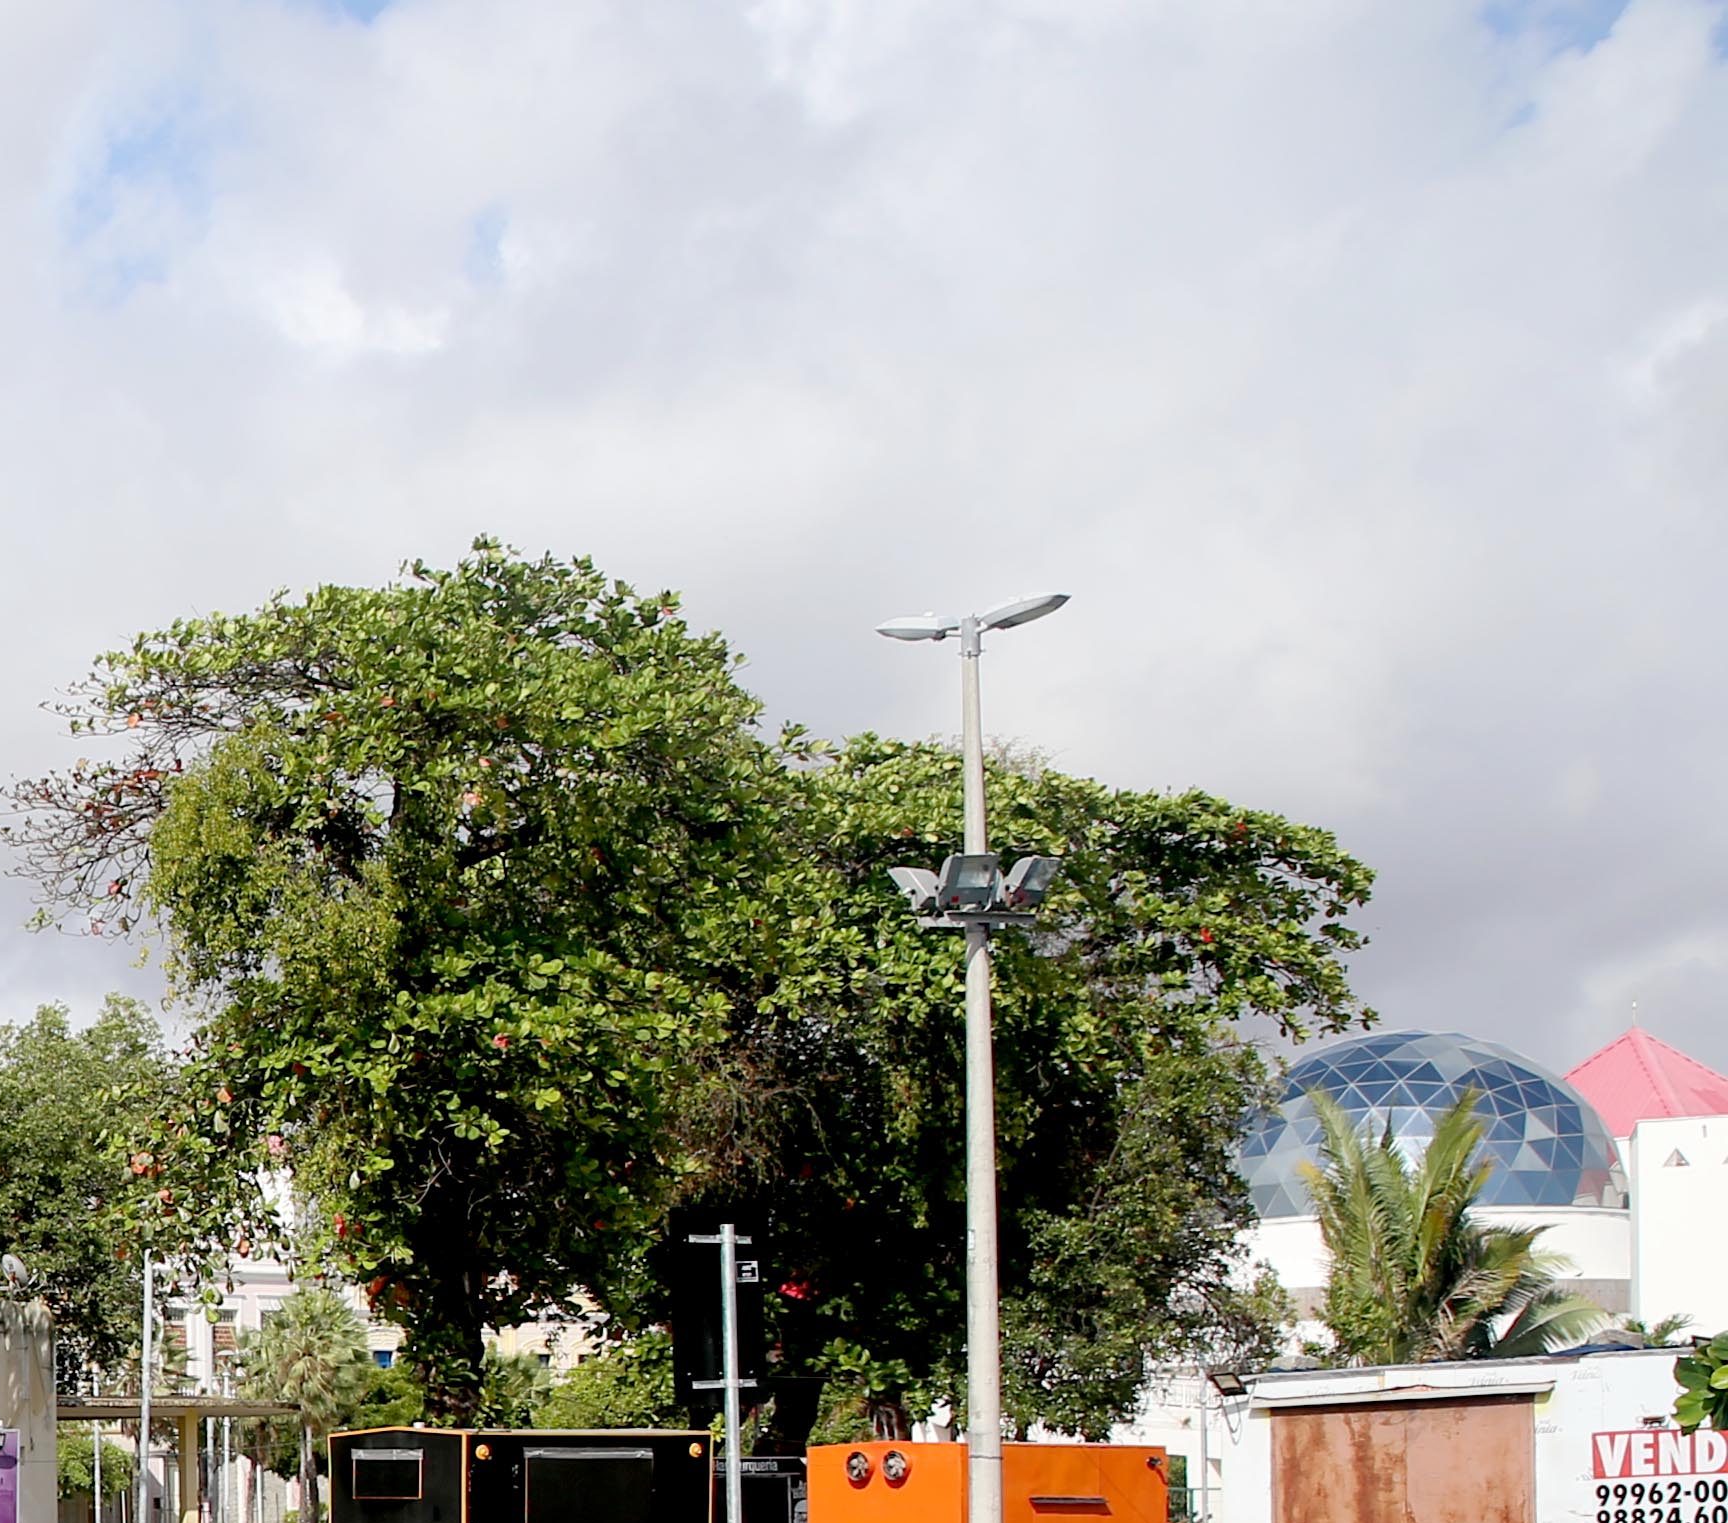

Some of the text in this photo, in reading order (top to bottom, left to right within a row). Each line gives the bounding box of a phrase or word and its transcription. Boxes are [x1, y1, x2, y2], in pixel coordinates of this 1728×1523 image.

[712, 1459, 778, 1474] Haurgueria
[1595, 1430, 1728, 1477] VEND
[1596, 1480, 1728, 1506] 99962-00
